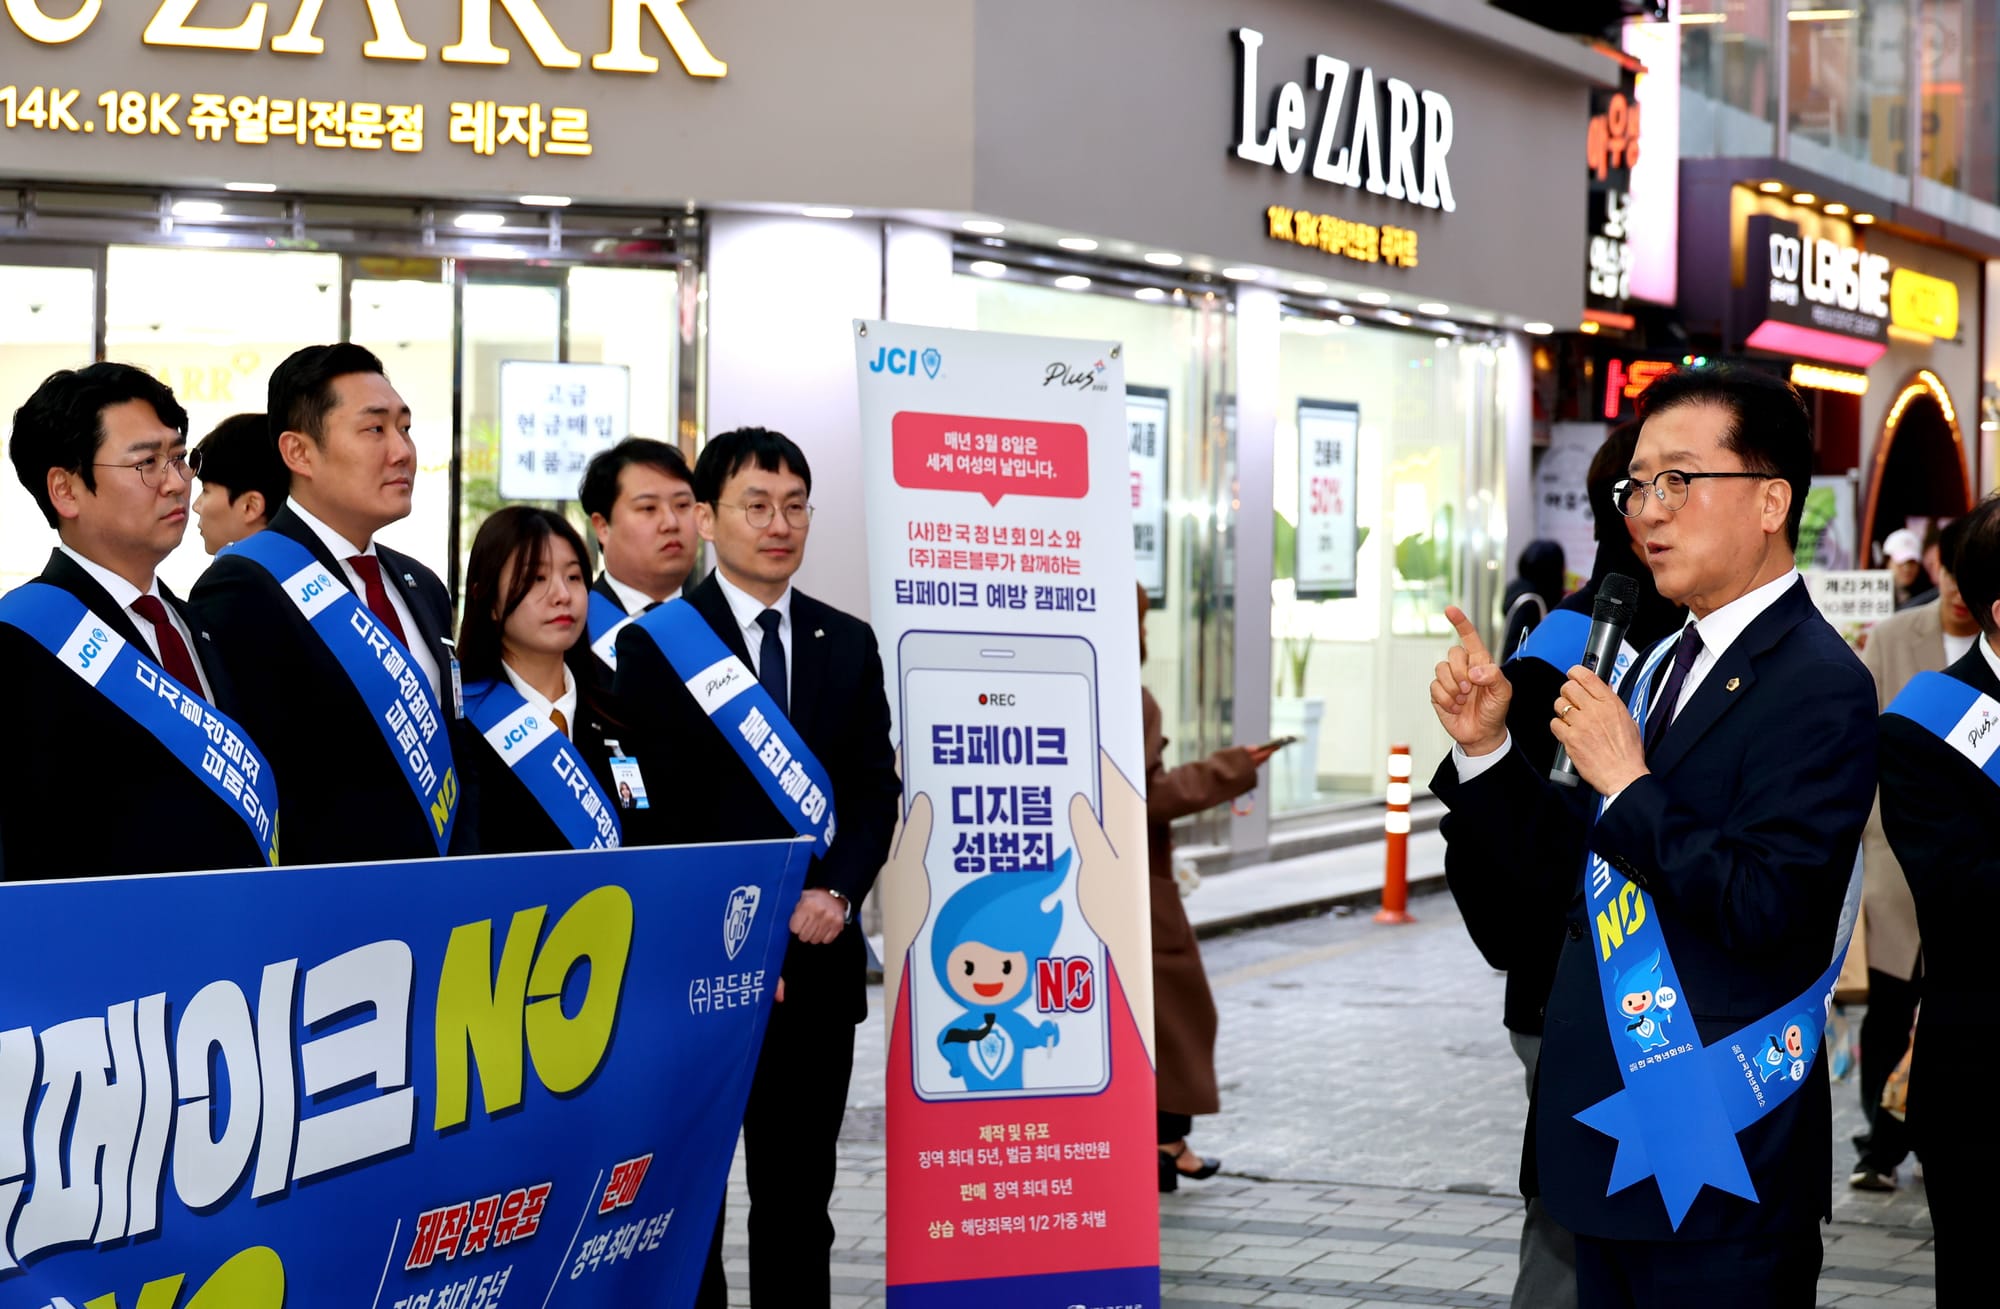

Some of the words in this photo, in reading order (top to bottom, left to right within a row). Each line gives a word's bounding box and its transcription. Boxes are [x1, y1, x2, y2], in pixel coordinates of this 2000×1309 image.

[187, 93, 424, 152] 쥬얼리전문점
[449, 100, 593, 157] 레자르
[869, 347, 917, 376] JCI
[1043, 361, 1094, 391] Plus
[944, 432, 971, 451] 매년
[975, 434, 998, 453] 3월
[1001, 436, 1037, 455] 8일은
[926, 453, 954, 472] 세계
[956, 455, 996, 475] 여성의
[1000, 458, 1057, 479] 날입니다.
[909, 548, 1016, 572] (주)골든블루가
[1020, 554, 1081, 575] 함께하는
[301, 579, 321, 603] JCI
[895, 579, 979, 608] 딥페이크
[987, 583, 1027, 610] 예방
[1034, 586, 1096, 613] 캠페인
[77, 637, 102, 669] JCI
[350, 606, 439, 743] 디지털성범죄
[989, 693, 1016, 706] REC
[136, 659, 260, 784] 디지털성범죄
[503, 724, 529, 751] JCI
[384, 699, 437, 797] 딥페이크
[932, 724, 1068, 766] 딥페이크
[202, 744, 270, 841] 딥페이크
[951, 785, 1053, 826] 디지털
[952, 832, 1054, 873] 성범죄
[1596, 880, 1647, 962] NO
[689, 970, 765, 1016] (주)골든블루
[1036, 956, 1095, 1013] NO
[0, 940, 414, 1271] 페이크
[434, 885, 634, 1131] NO
[979, 1124, 1005, 1143] 제작
[1008, 1123, 1021, 1141] 및
[1024, 1123, 1050, 1140] 유포
[918, 1151, 944, 1169] 징역
[948, 1149, 974, 1166] 최대
[977, 1147, 1003, 1167] 5년,
[1006, 1145, 1032, 1164] 벌금
[1035, 1143, 1061, 1161] 최대
[1064, 1141, 1110, 1160] 5천만원
[599, 1153, 653, 1215] 판매
[960, 1182, 987, 1201] 판매
[993, 1181, 1019, 1200] 징역
[1022, 1179, 1048, 1197] 최대
[1051, 1178, 1073, 1195] 5년
[570, 1230, 606, 1280] 징역
[604, 1217, 642, 1264] 최대
[639, 1208, 675, 1251] 5년
[928, 1221, 955, 1239] 상습
[961, 1216, 1025, 1236] 해당죄목의
[1029, 1214, 1050, 1232] 1/2
[1053, 1212, 1079, 1230] 가중
[1081, 1210, 1106, 1228] 처벌
